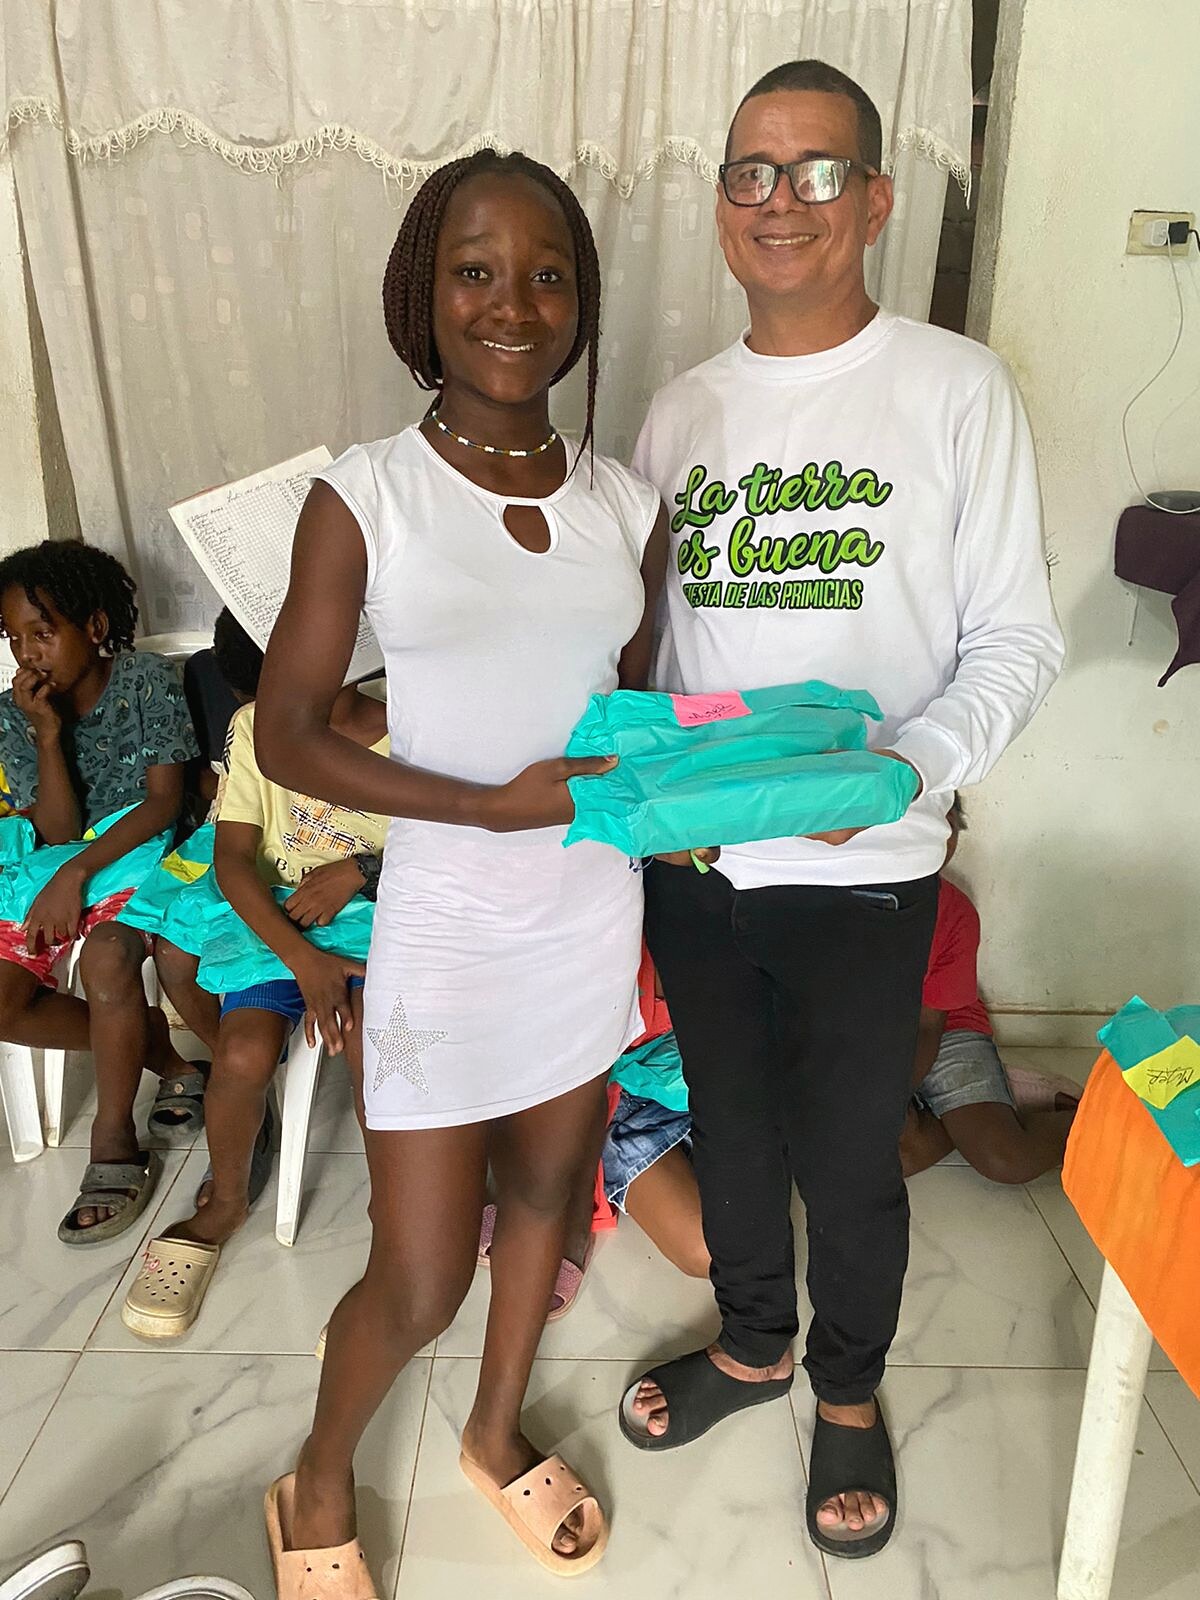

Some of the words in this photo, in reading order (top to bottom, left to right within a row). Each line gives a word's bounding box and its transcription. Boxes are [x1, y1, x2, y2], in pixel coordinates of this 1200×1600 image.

[671, 465, 738, 533] La
[739, 460, 893, 516] tierra
[677, 529, 721, 579] es
[728, 515, 885, 577] buena
[724, 582, 749, 608] DE
[749, 581, 780, 608] LAS
[779, 579, 864, 609] PRIMICIAS
